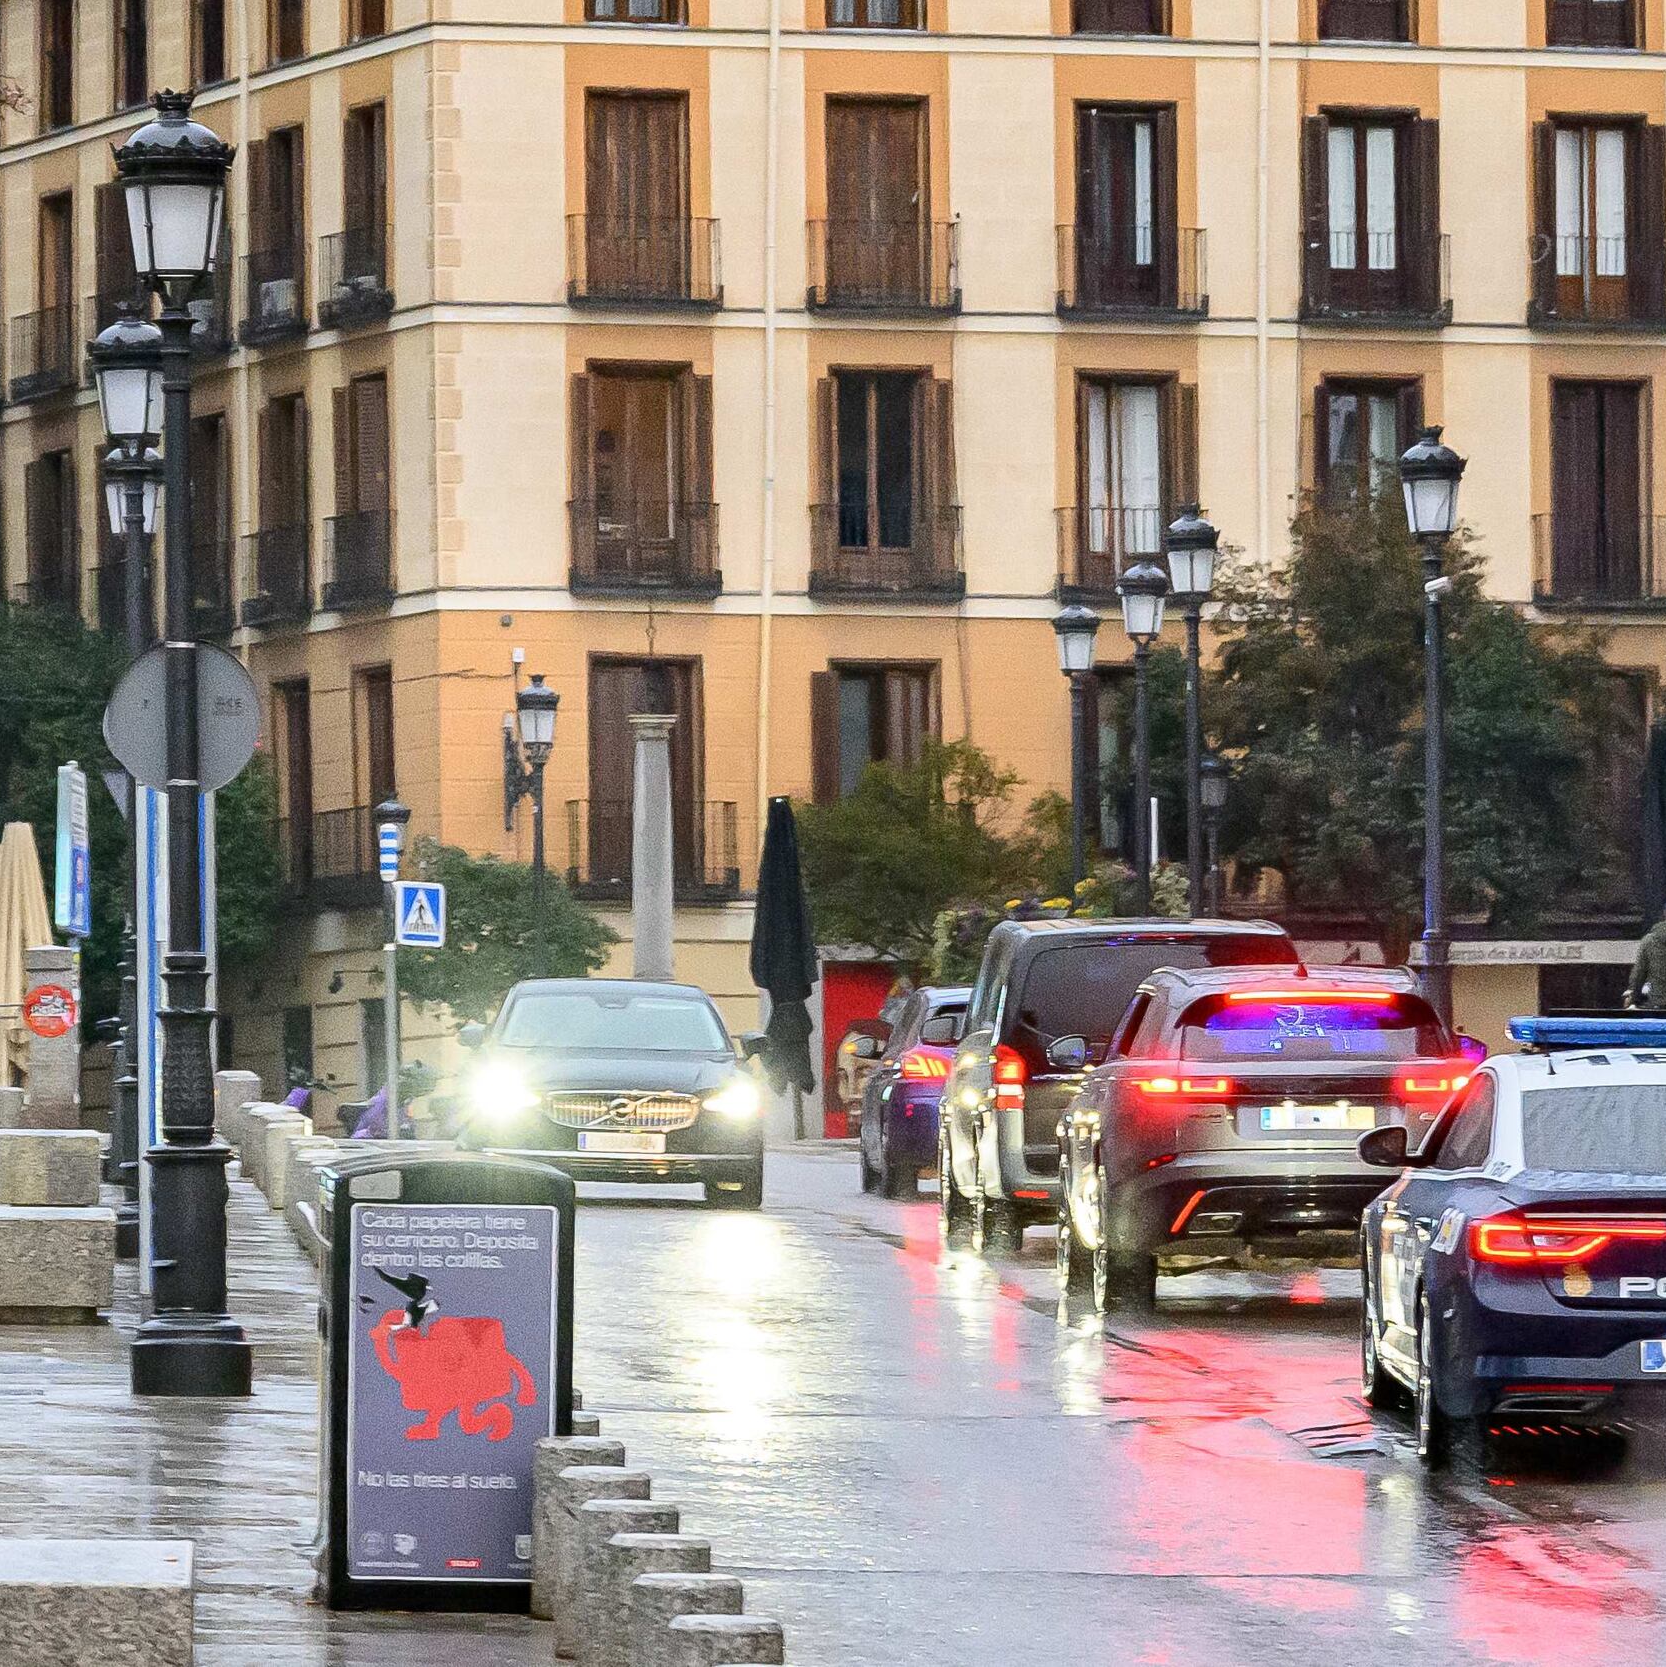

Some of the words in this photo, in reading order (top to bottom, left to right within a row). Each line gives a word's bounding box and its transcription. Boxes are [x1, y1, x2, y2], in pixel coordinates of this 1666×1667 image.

[361, 1211, 406, 1228] Cada
[409, 1214, 482, 1232] papelera
[484, 1215, 526, 1230] tiene
[361, 1235, 383, 1247] su
[464, 1233, 539, 1251] Deposita
[361, 1251, 416, 1267] dentro
[418, 1251, 443, 1268] las
[358, 1470, 383, 1487] No
[386, 1471, 411, 1488] las
[413, 1472, 450, 1488] tires
[452, 1472, 467, 1489] al
